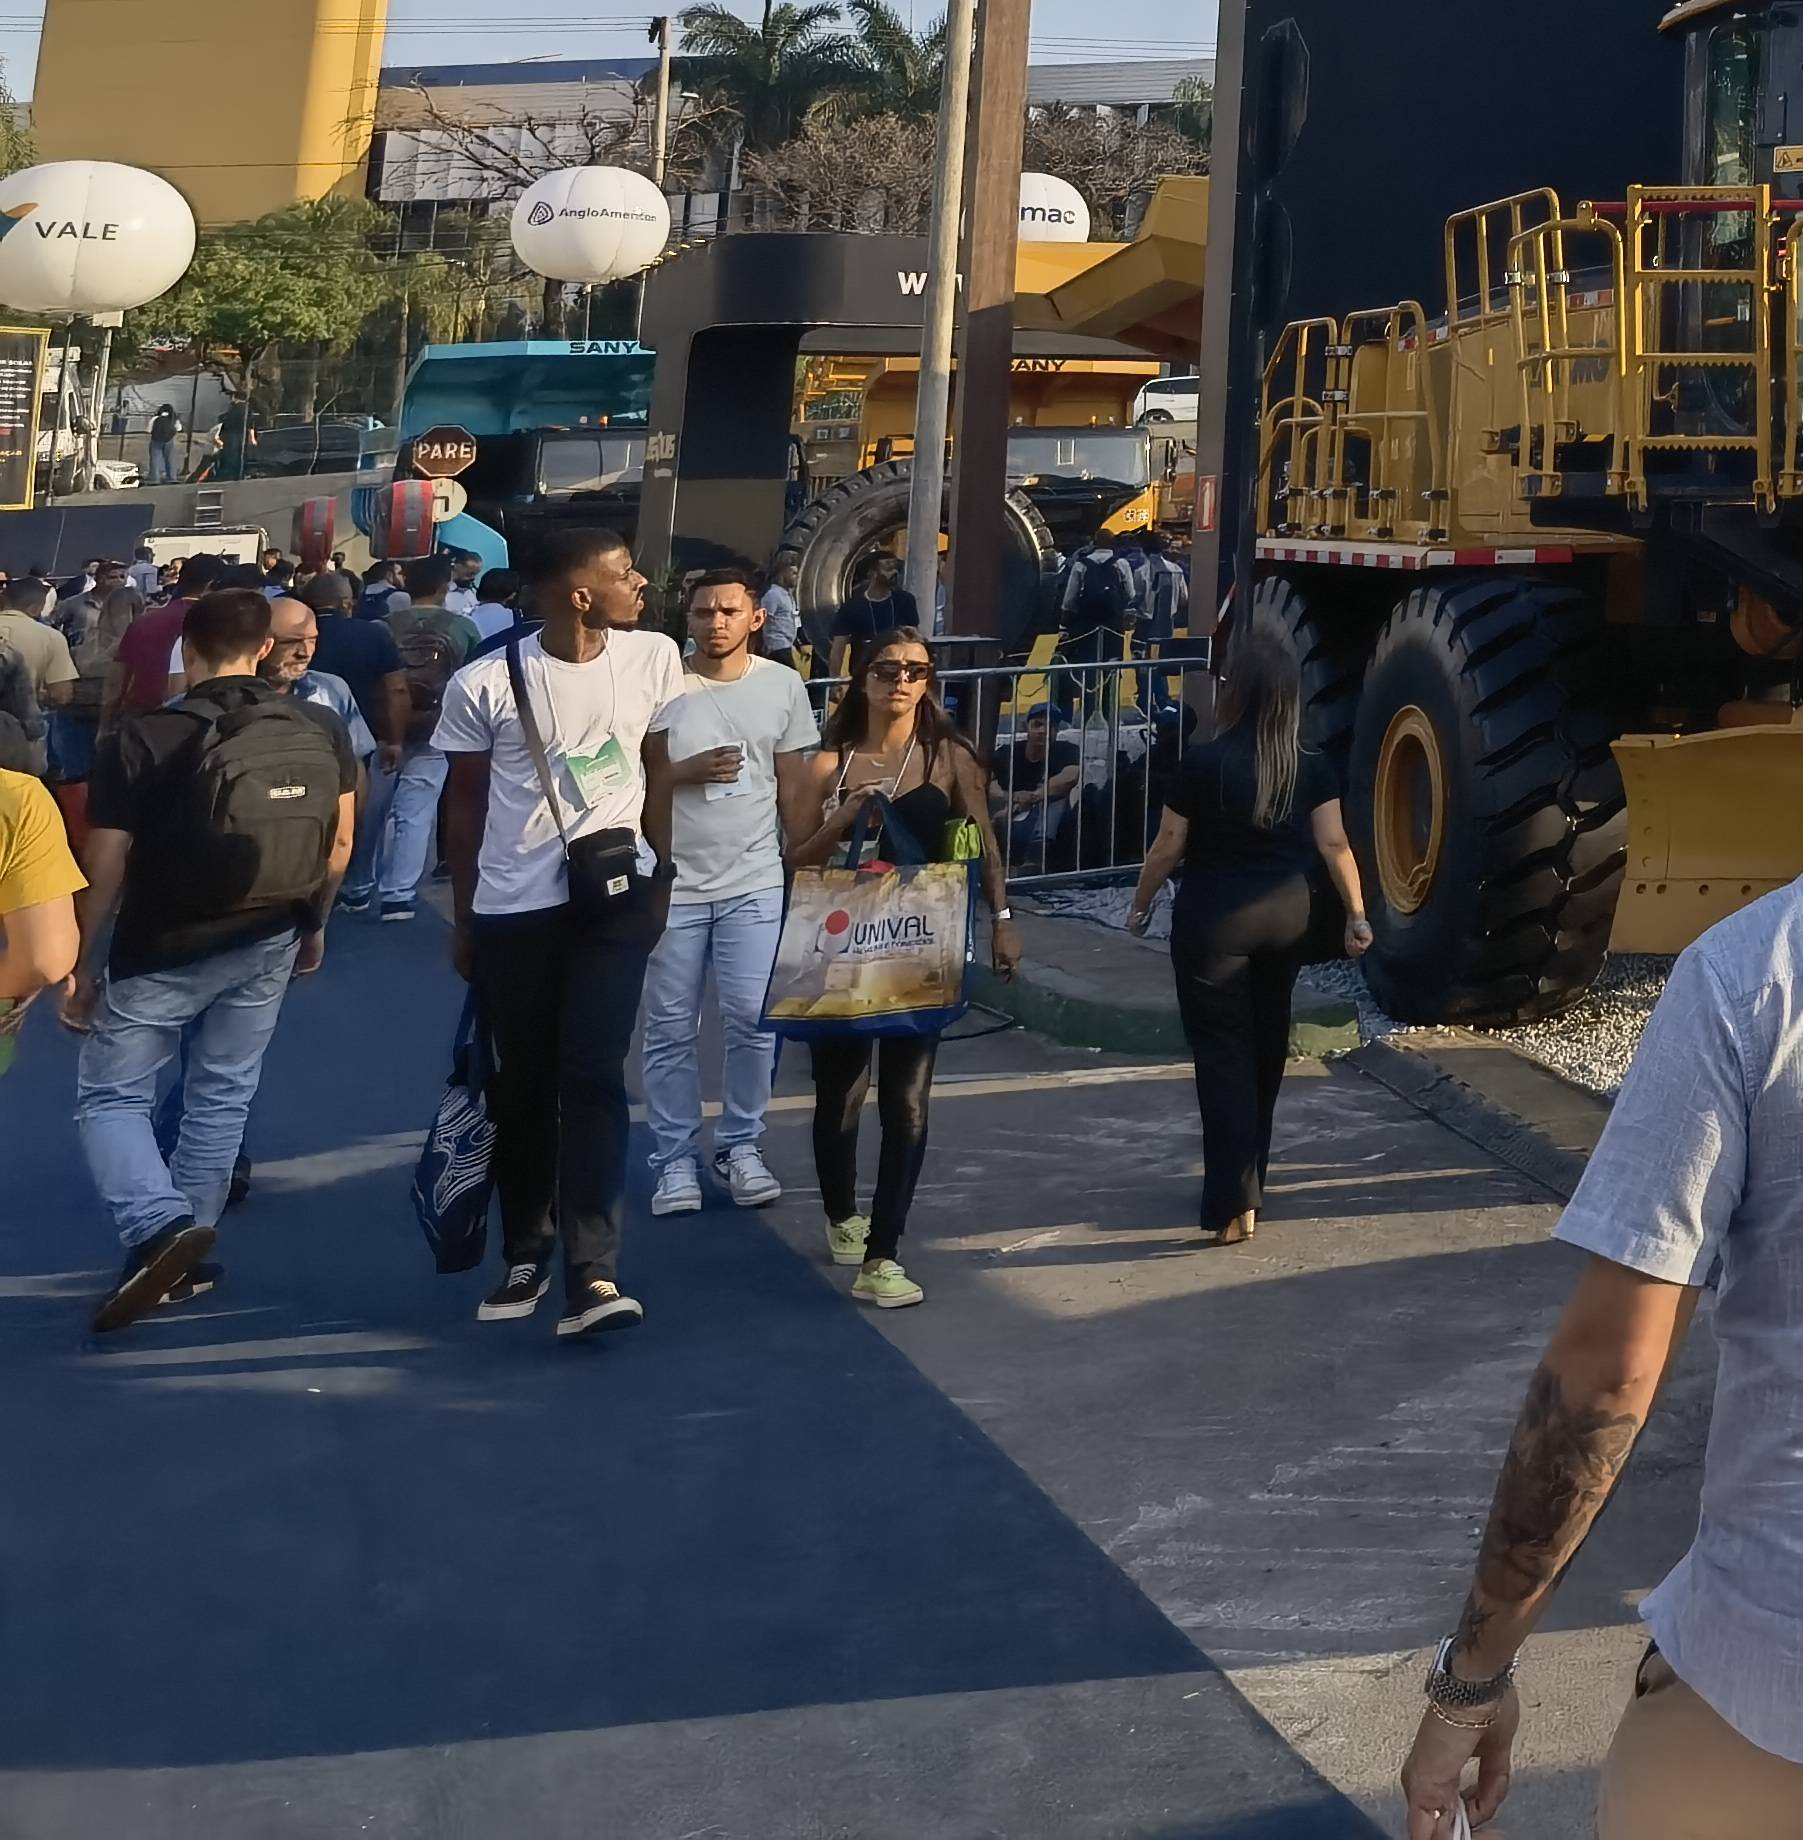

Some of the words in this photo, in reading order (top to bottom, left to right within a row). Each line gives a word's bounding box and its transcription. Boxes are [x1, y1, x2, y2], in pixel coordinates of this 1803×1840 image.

[1019, 206, 1076, 224] mac
[35, 221, 119, 241] VALE
[569, 341, 637, 354] SANY
[417, 442, 472, 459] PARE
[854, 914, 935, 945] UNIVAL
